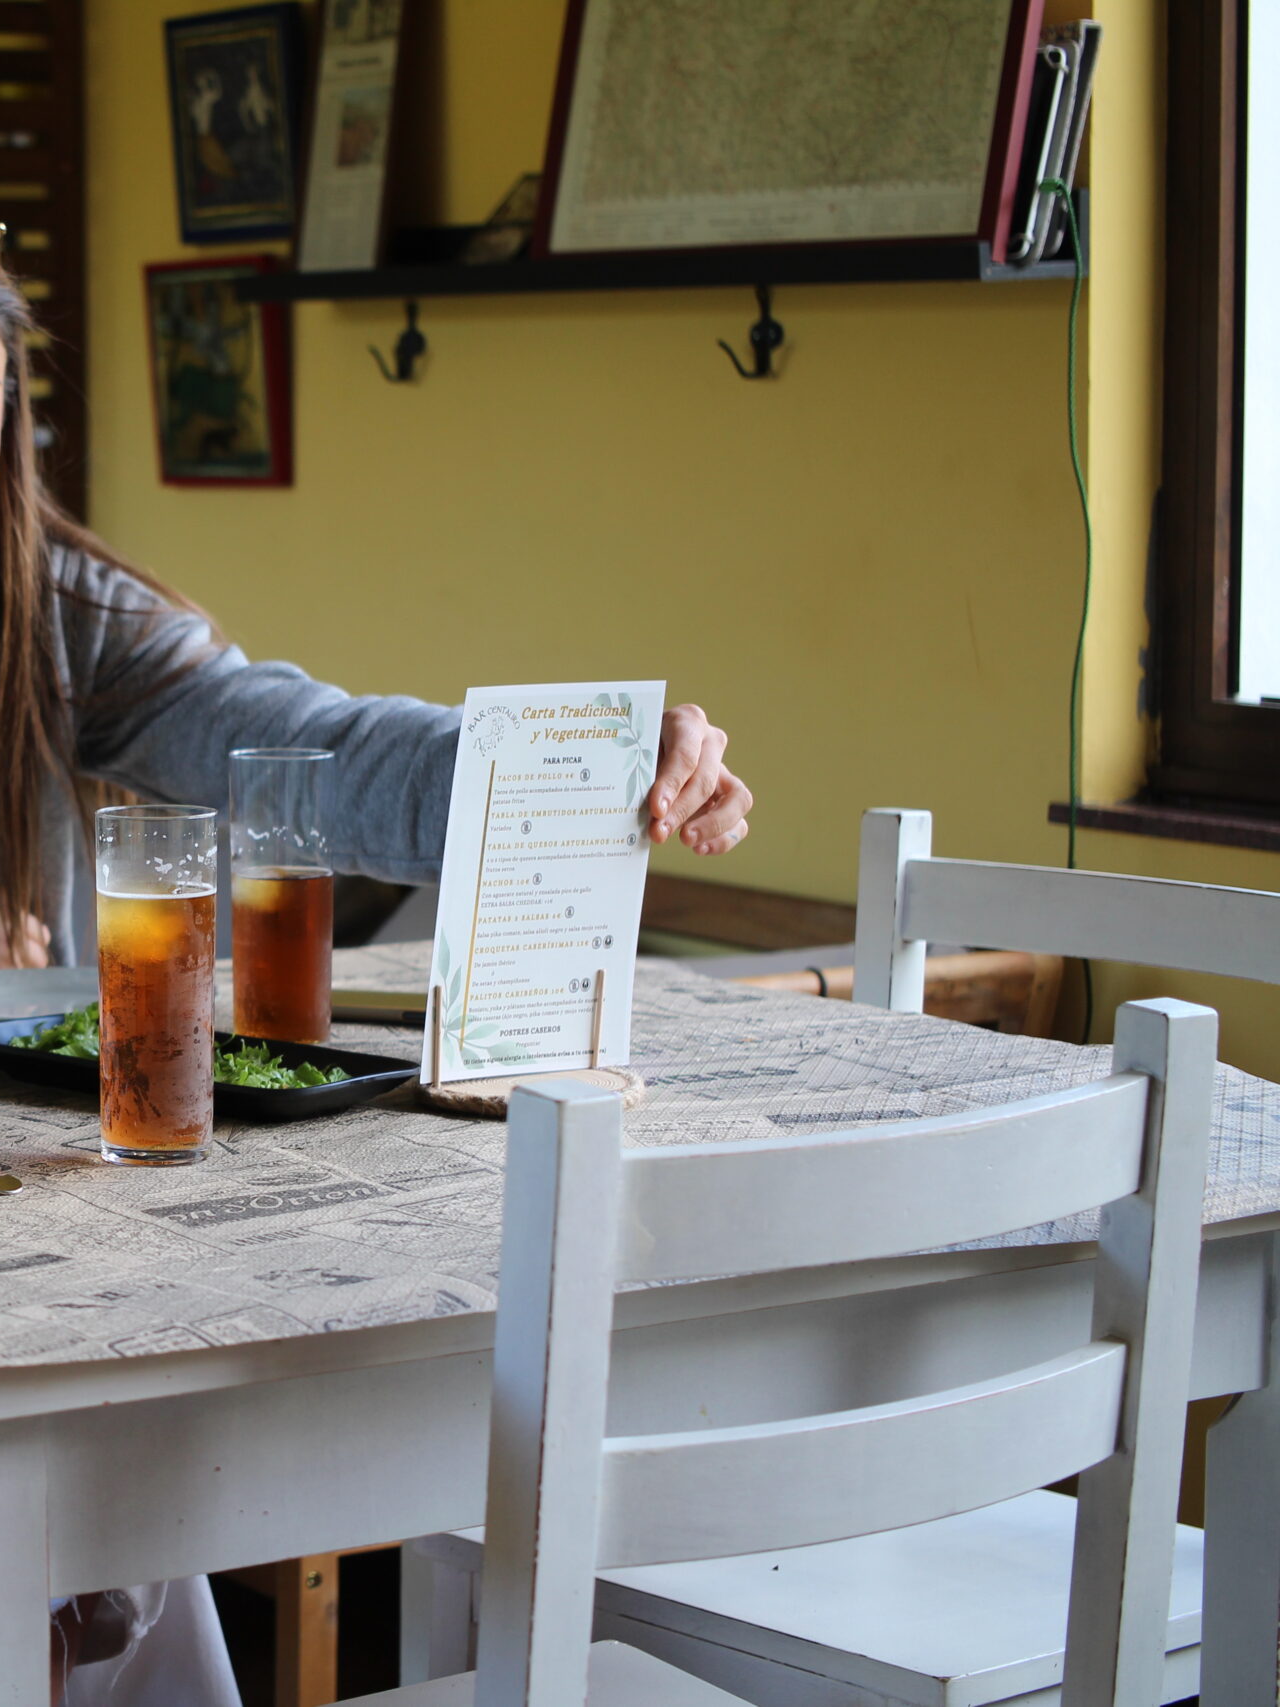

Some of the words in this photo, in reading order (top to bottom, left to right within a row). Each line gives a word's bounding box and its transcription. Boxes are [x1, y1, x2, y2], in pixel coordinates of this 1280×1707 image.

[522, 706, 556, 720] Carta
[560, 702, 632, 718] Tradicional
[468, 710, 486, 732] BAR
[487, 706, 520, 730] CENTAURO
[530, 730, 540, 744] y
[544, 725, 618, 744] Vegetariana
[580, 807, 628, 816] ASTURIANOS
[528, 841, 557, 850] QUESOS
[561, 838, 609, 847] ASTURIANOS
[479, 916, 511, 924] PATATAS
[474, 945, 520, 954] CROQUETAS
[470, 992, 502, 1000] PALITOS
[505, 988, 548, 998] CARIBEÑOS
[500, 1028, 529, 1037] POSTRES
[530, 1025, 561, 1034] CASEROS
